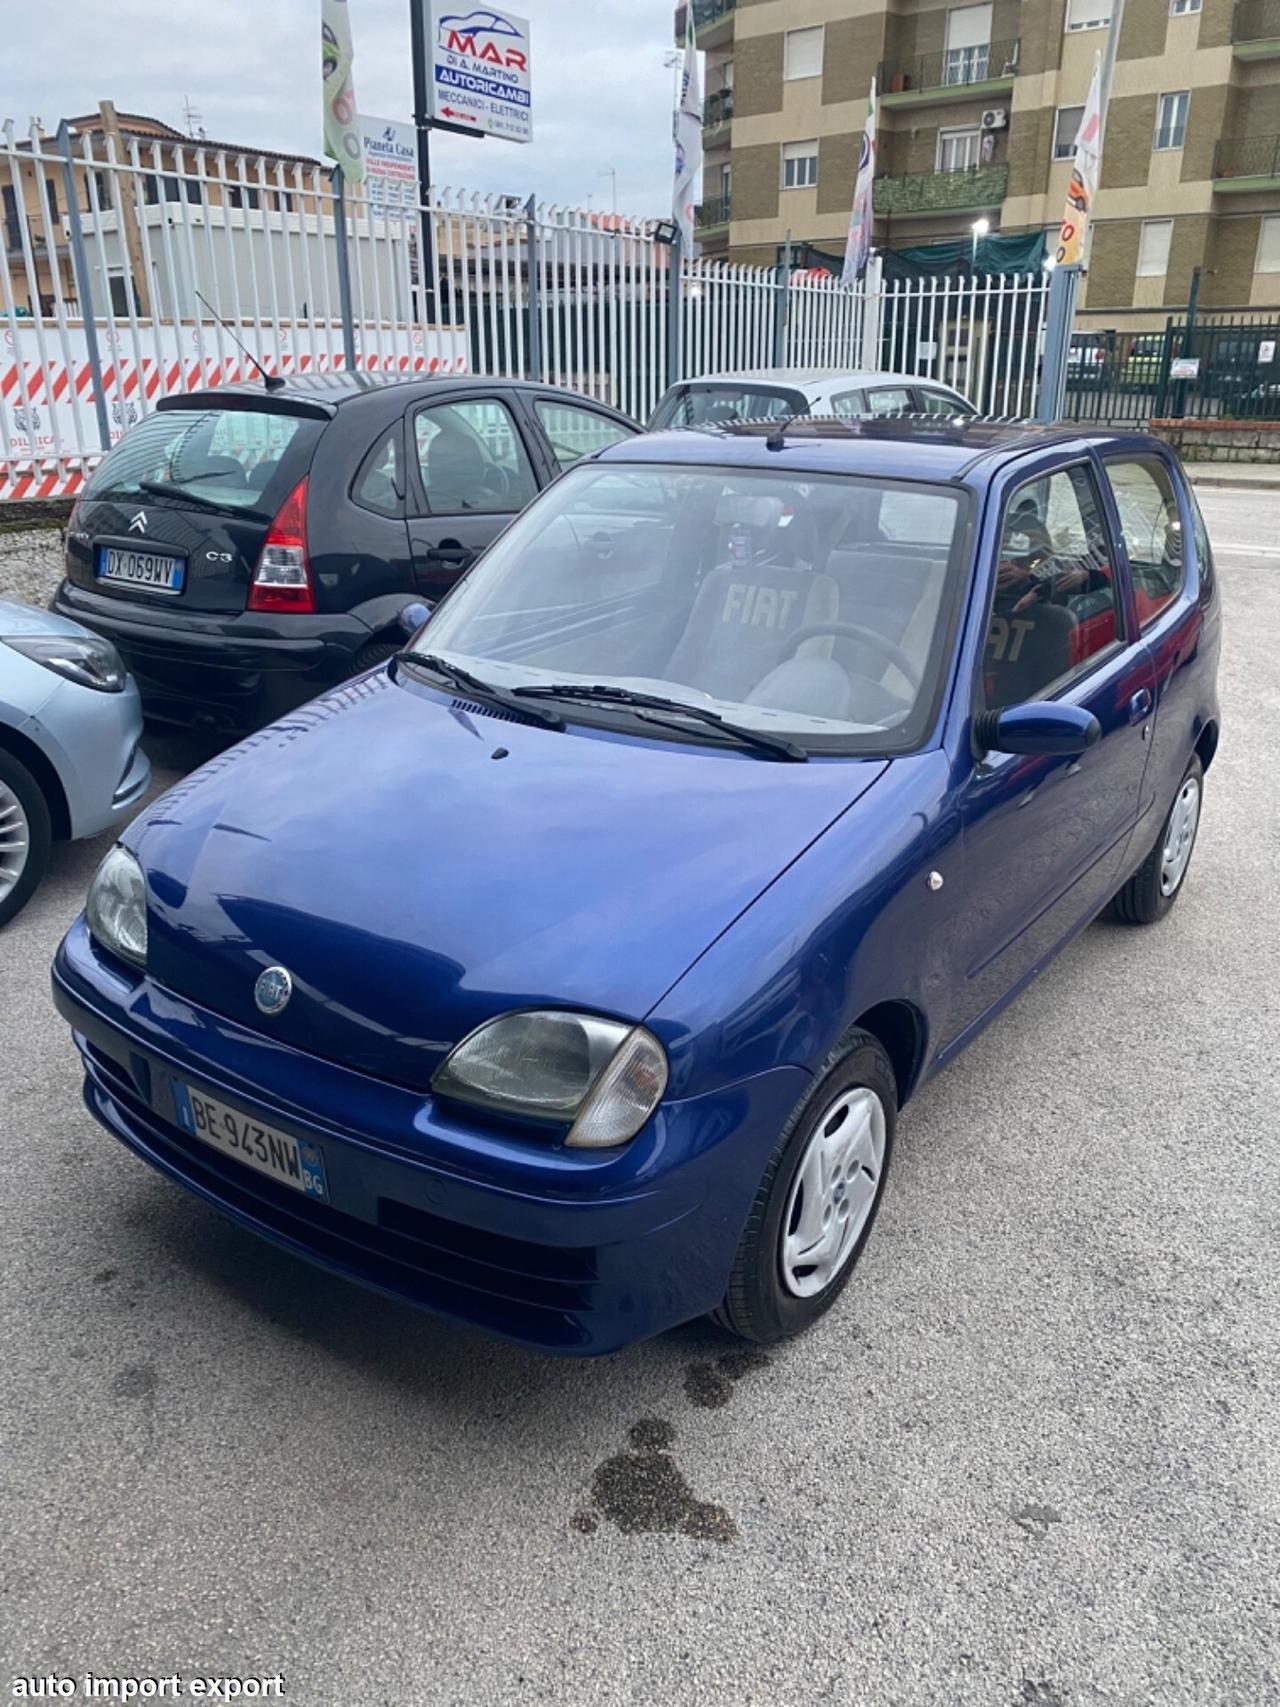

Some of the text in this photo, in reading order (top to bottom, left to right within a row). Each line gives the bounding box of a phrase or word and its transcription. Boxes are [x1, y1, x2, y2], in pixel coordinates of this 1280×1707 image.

[446, 54, 458, 66] DI
[472, 61, 519, 84] MARTINO
[447, 31, 527, 73] MAR
[439, 68, 529, 105] AUTORICAMBI
[438, 89, 485, 111] MECCANICI
[490, 103, 529, 122] ELETTRICI
[363, 136, 394, 154] Pianeta
[395, 141, 414, 158] Casa
[205, 551, 233, 563] C3
[722, 583, 799, 630] FIAT
[989, 617, 1035, 661] AT
[191, 1096, 222, 1140] BE
[224, 1112, 300, 1181] 943NW
[303, 1168, 323, 1195] BG
